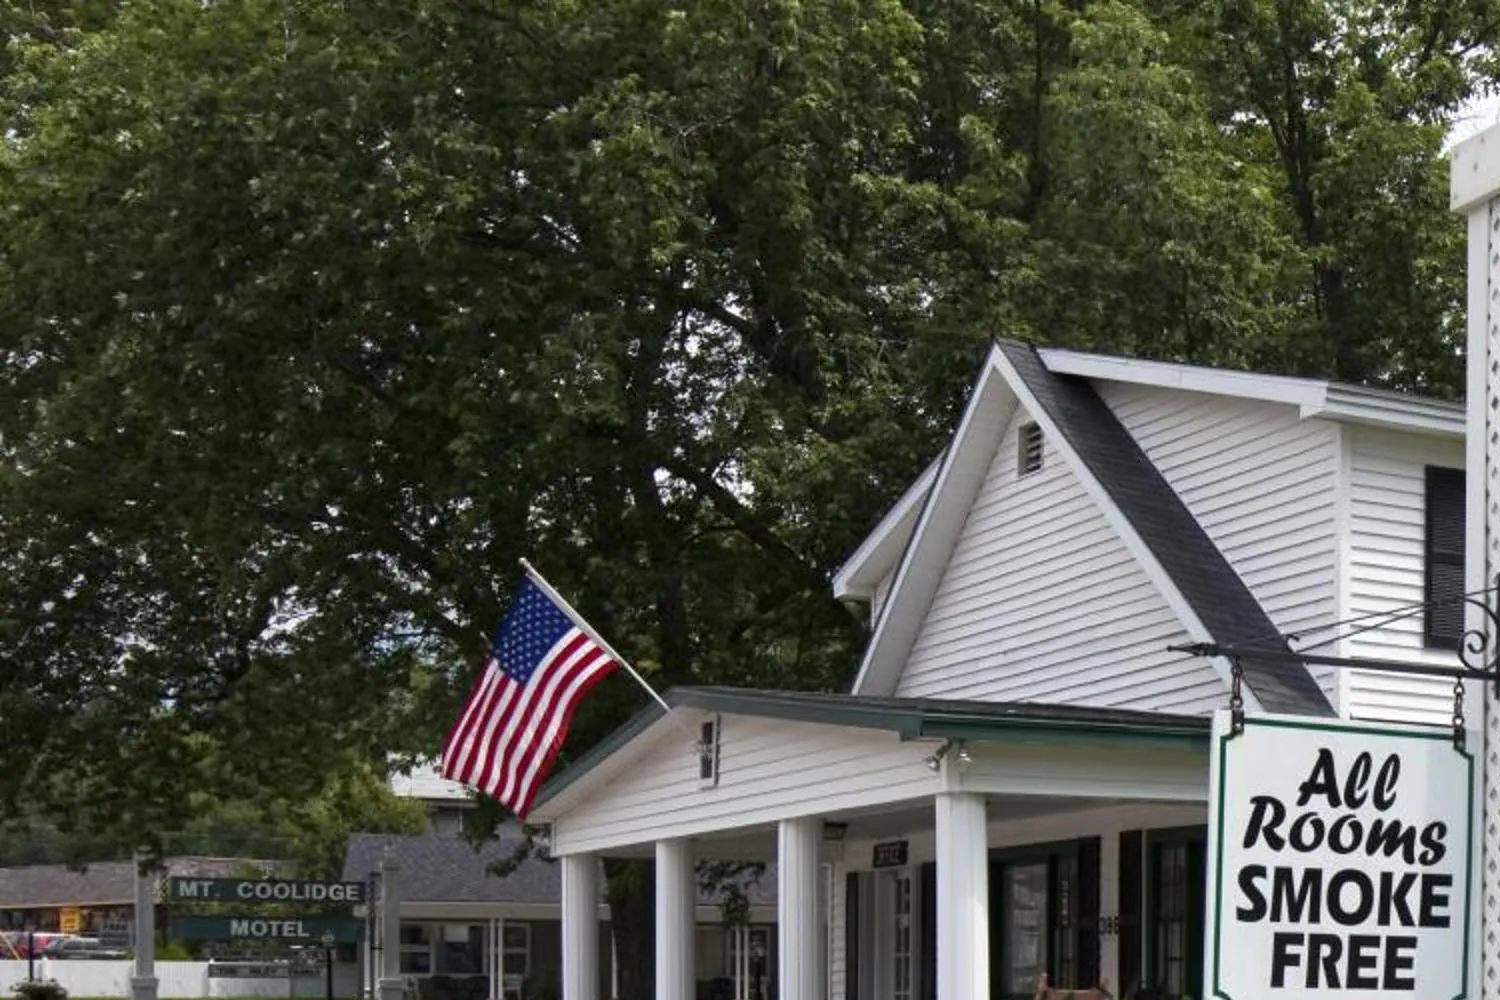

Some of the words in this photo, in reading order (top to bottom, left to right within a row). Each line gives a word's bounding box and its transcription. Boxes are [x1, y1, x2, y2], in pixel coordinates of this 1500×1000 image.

[1296, 747, 1401, 812] All
[1242, 795, 1448, 866] Rooms
[179, 880, 220, 897] MT.
[236, 881, 360, 900] COOLIDGE
[1235, 864, 1453, 928] SMOKE
[230, 919, 310, 937] MOTEL
[1270, 932, 1418, 990] FREE
